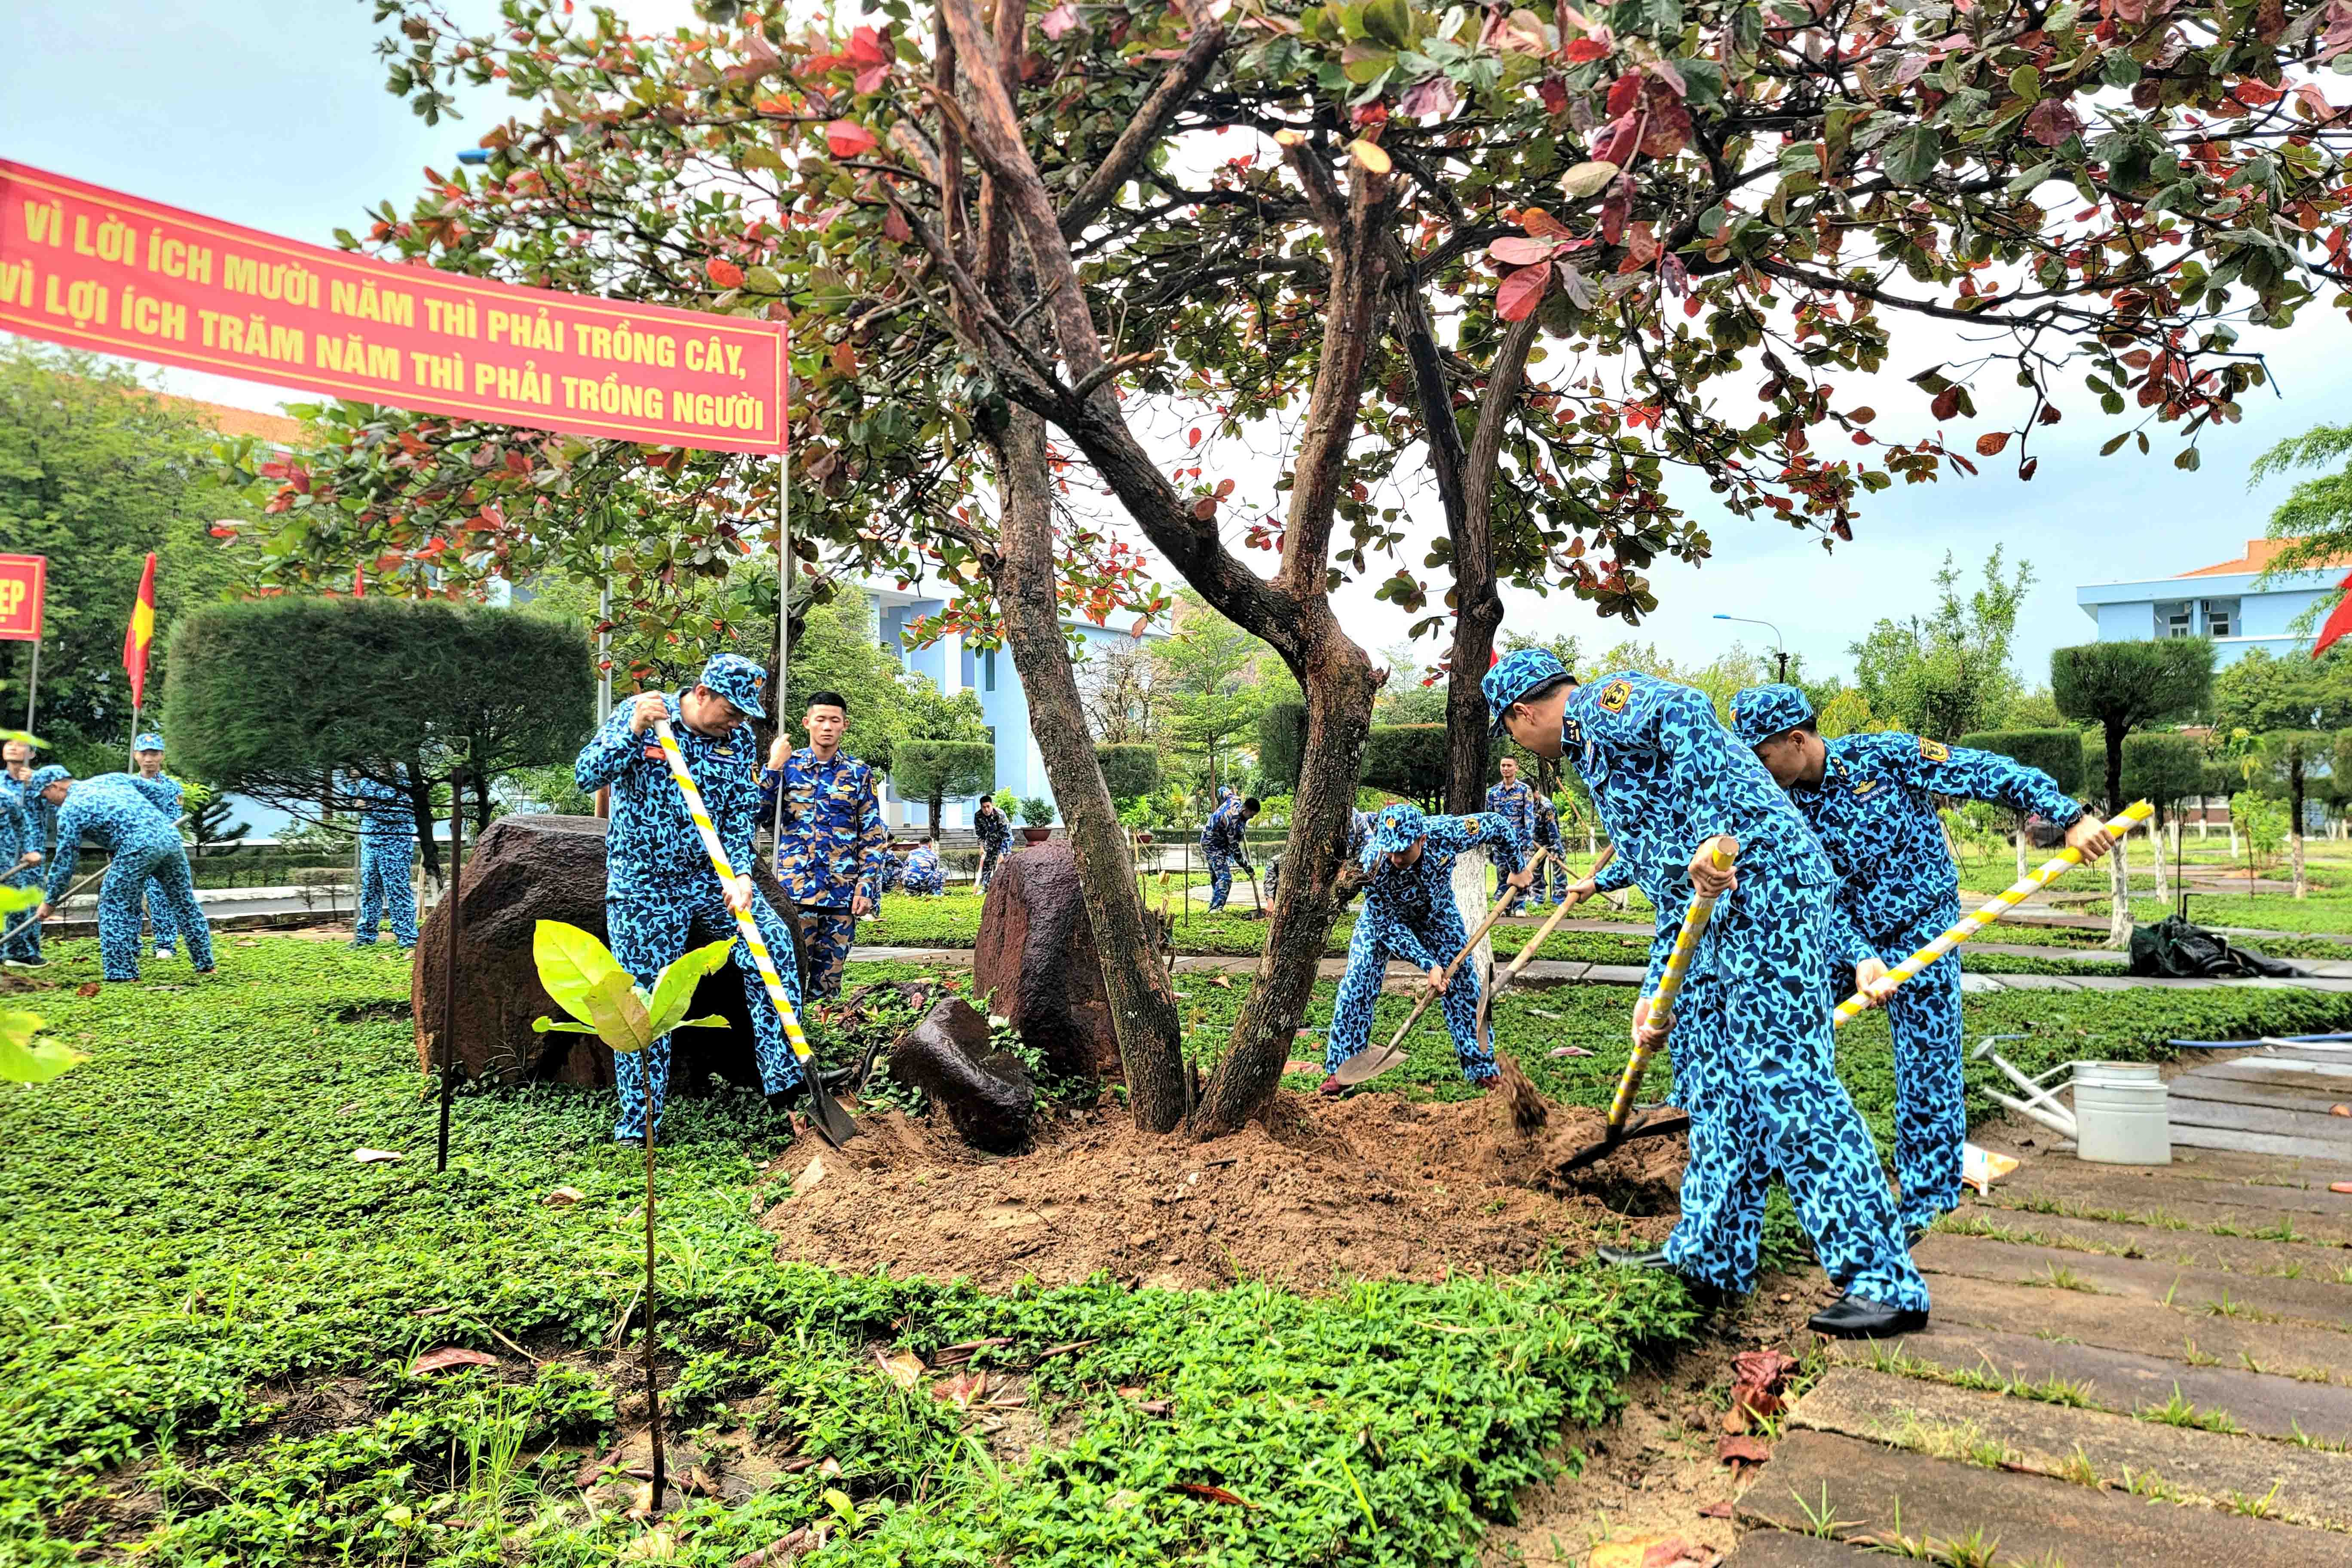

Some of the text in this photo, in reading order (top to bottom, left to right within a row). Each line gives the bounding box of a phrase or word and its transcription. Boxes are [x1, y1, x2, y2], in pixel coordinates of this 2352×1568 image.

[0, 260, 763, 431] VÌ LỢI ÍCH TRĂM NĂM THÌ PHẢI TRỒNG NGƯỜI
[25, 200, 747, 380] VÌ LỜI ÍCH MƯỜI NĂM THÌ PHẢI TRỒNG CÂY,
